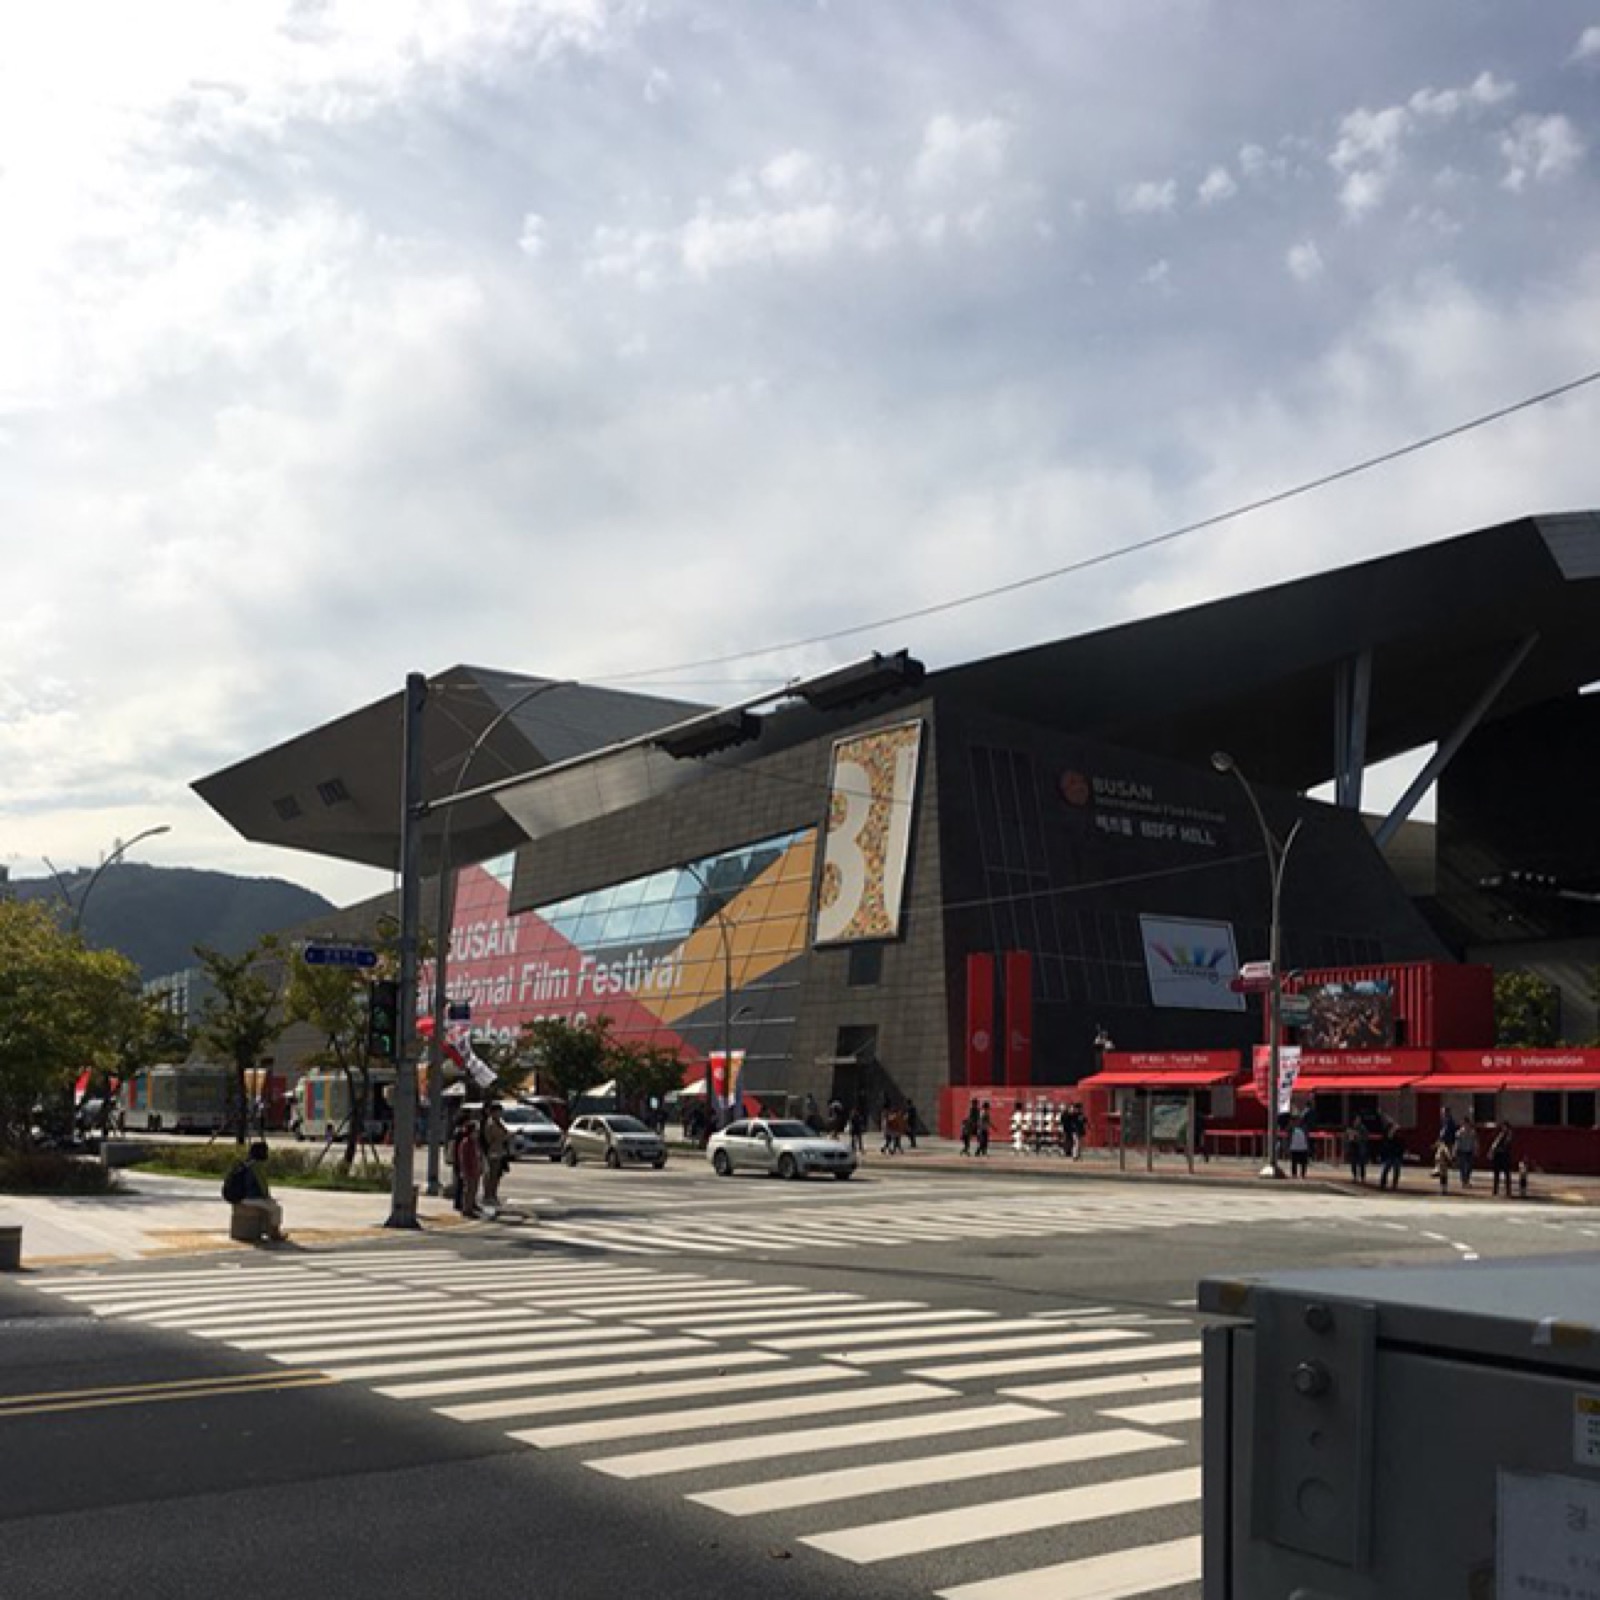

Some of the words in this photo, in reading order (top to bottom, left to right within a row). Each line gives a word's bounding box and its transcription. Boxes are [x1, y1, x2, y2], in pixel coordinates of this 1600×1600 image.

[1092, 777, 1153, 800] BUSAN
[519, 961, 570, 1002] Film
[577, 945, 685, 996] Festival
[1521, 1055, 1583, 1067] Information
